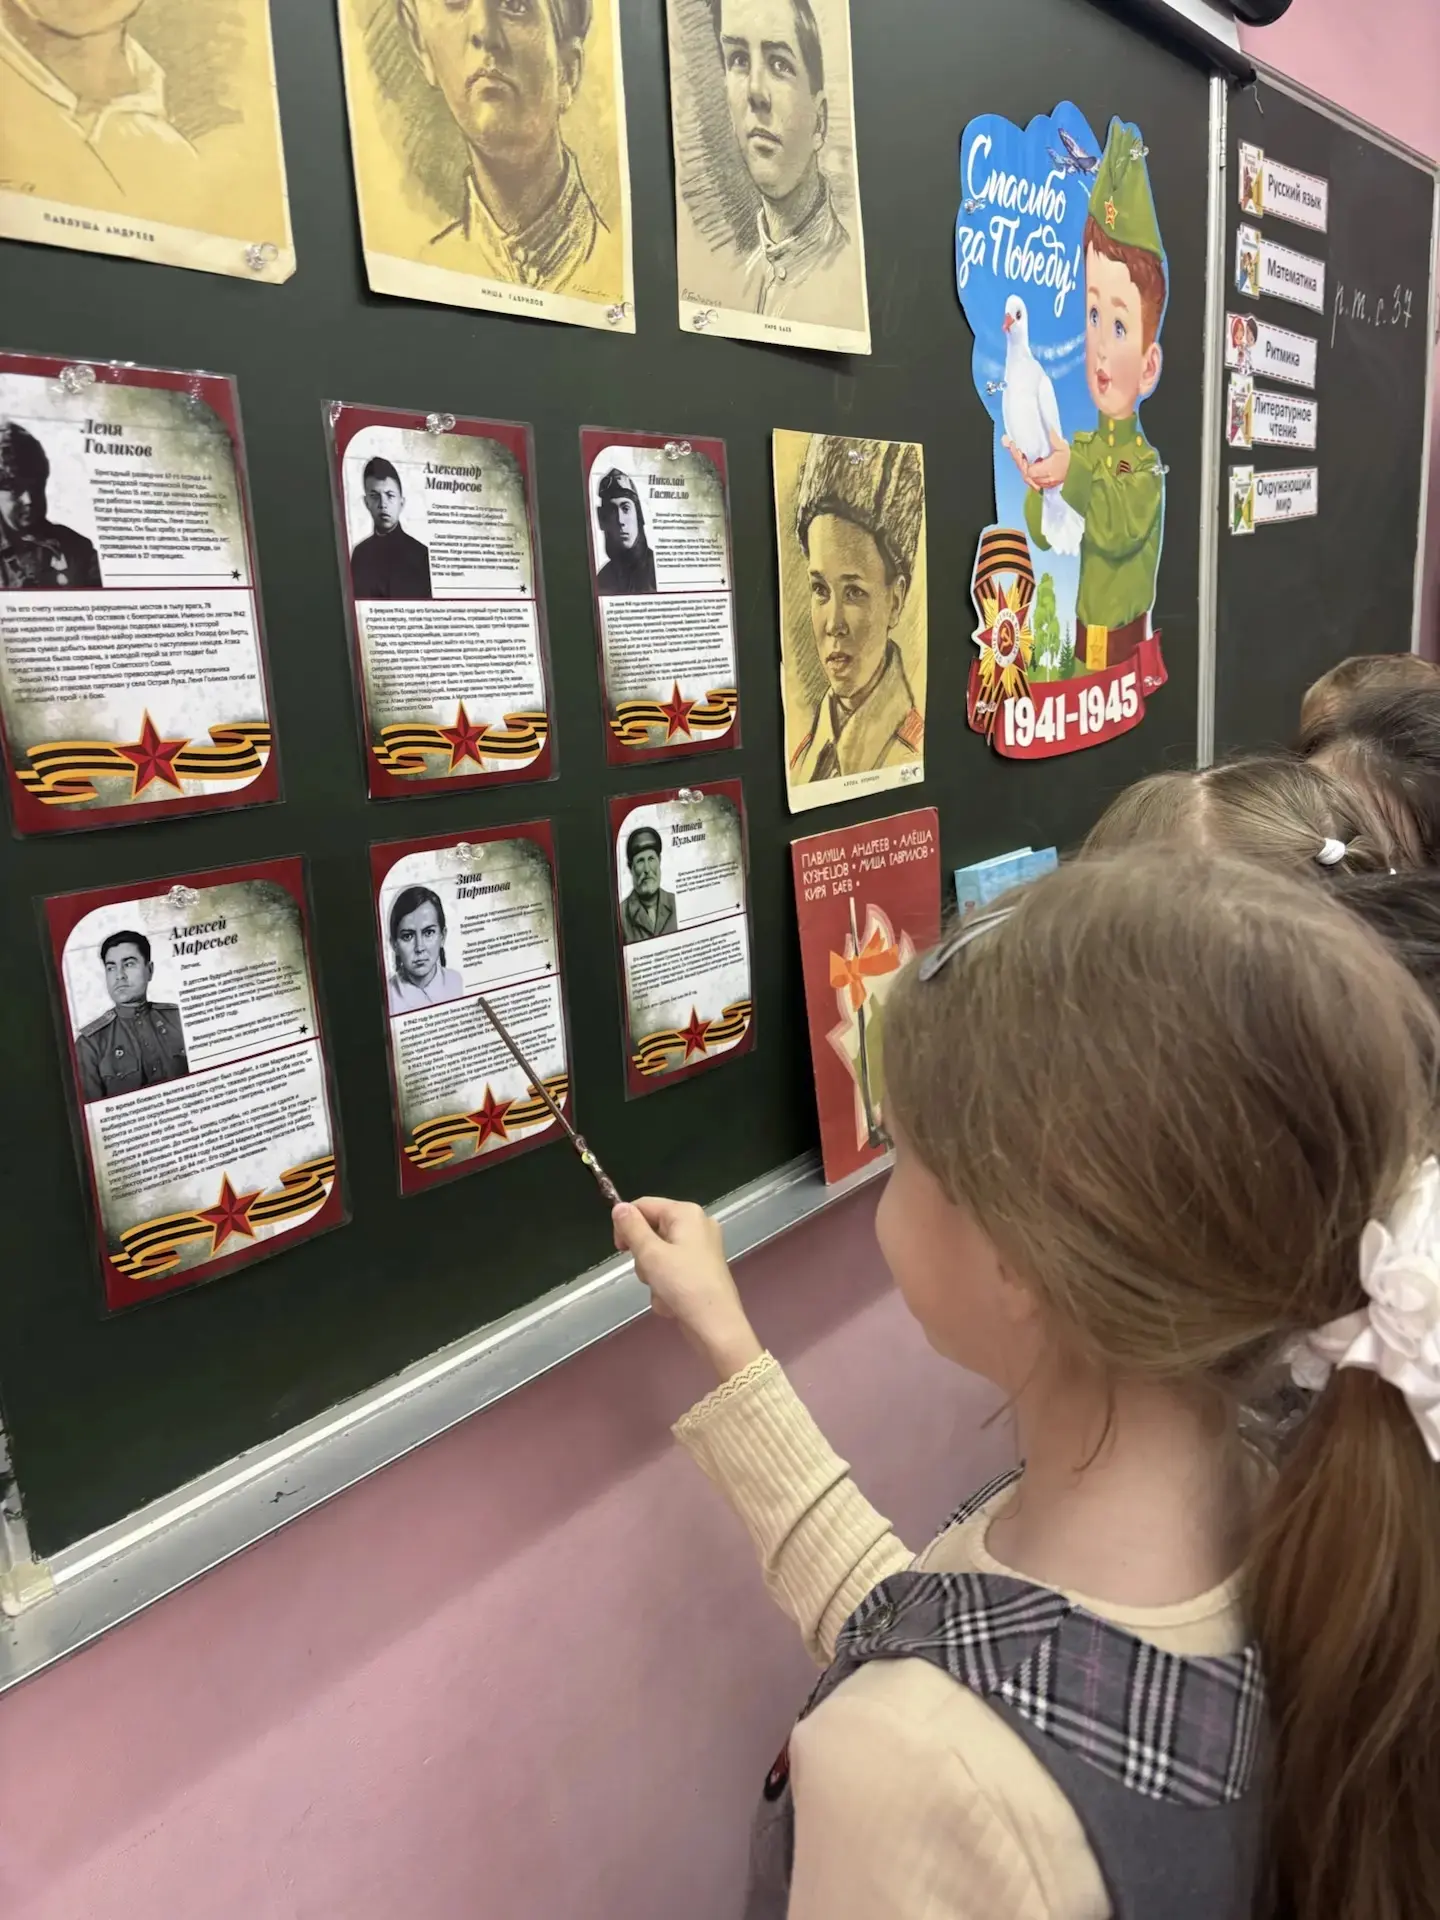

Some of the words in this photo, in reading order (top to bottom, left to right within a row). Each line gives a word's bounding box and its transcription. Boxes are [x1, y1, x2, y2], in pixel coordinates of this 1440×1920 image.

[967, 134, 1067, 225] Спасибо
[1268, 174, 1301, 204] Русский
[1302, 192, 1322, 210] язык
[43, 213, 99, 231] ПАВЛУША
[106, 226, 154, 242] АНДРЕЕВ
[959, 227, 986, 288] за
[989, 215, 1081, 318] Победу!
[1267, 257, 1317, 292] Математика
[1265, 341, 1300, 367] Ритмика
[1254, 396, 1312, 423] Литературное
[80, 418, 123, 436] Леня
[1269, 422, 1298, 439] чтение
[84, 438, 152, 458] Голиков
[423, 462, 482, 478] Александр
[648, 475, 685, 486] Николай
[425, 478, 482, 494] Матросов
[649, 490, 690, 499] Гастелло
[1257, 473, 1312, 499] Окружающий
[1276, 496, 1292, 513] мир
[1004, 672, 1138, 747] 1941-1945
[671, 818, 703, 834] Матвей
[671, 833, 706, 848] Кузьмин
[802, 848, 846, 868] ПАВЛУША
[851, 838, 890, 858] АНДРЕЕВ
[900, 830, 932, 848] АЛЁША
[803, 863, 849, 884] КУЗНЕЦОВ
[859, 856, 887, 872] МИША
[890, 846, 928, 866] ГАВРИЛОВ
[455, 872, 482, 885] Зина
[457, 881, 511, 900] Портнова
[805, 885, 826, 901] КИРЯ
[833, 880, 853, 895] БАЕВ
[169, 916, 227, 940] Алексей
[172, 933, 239, 958] Маресьев
